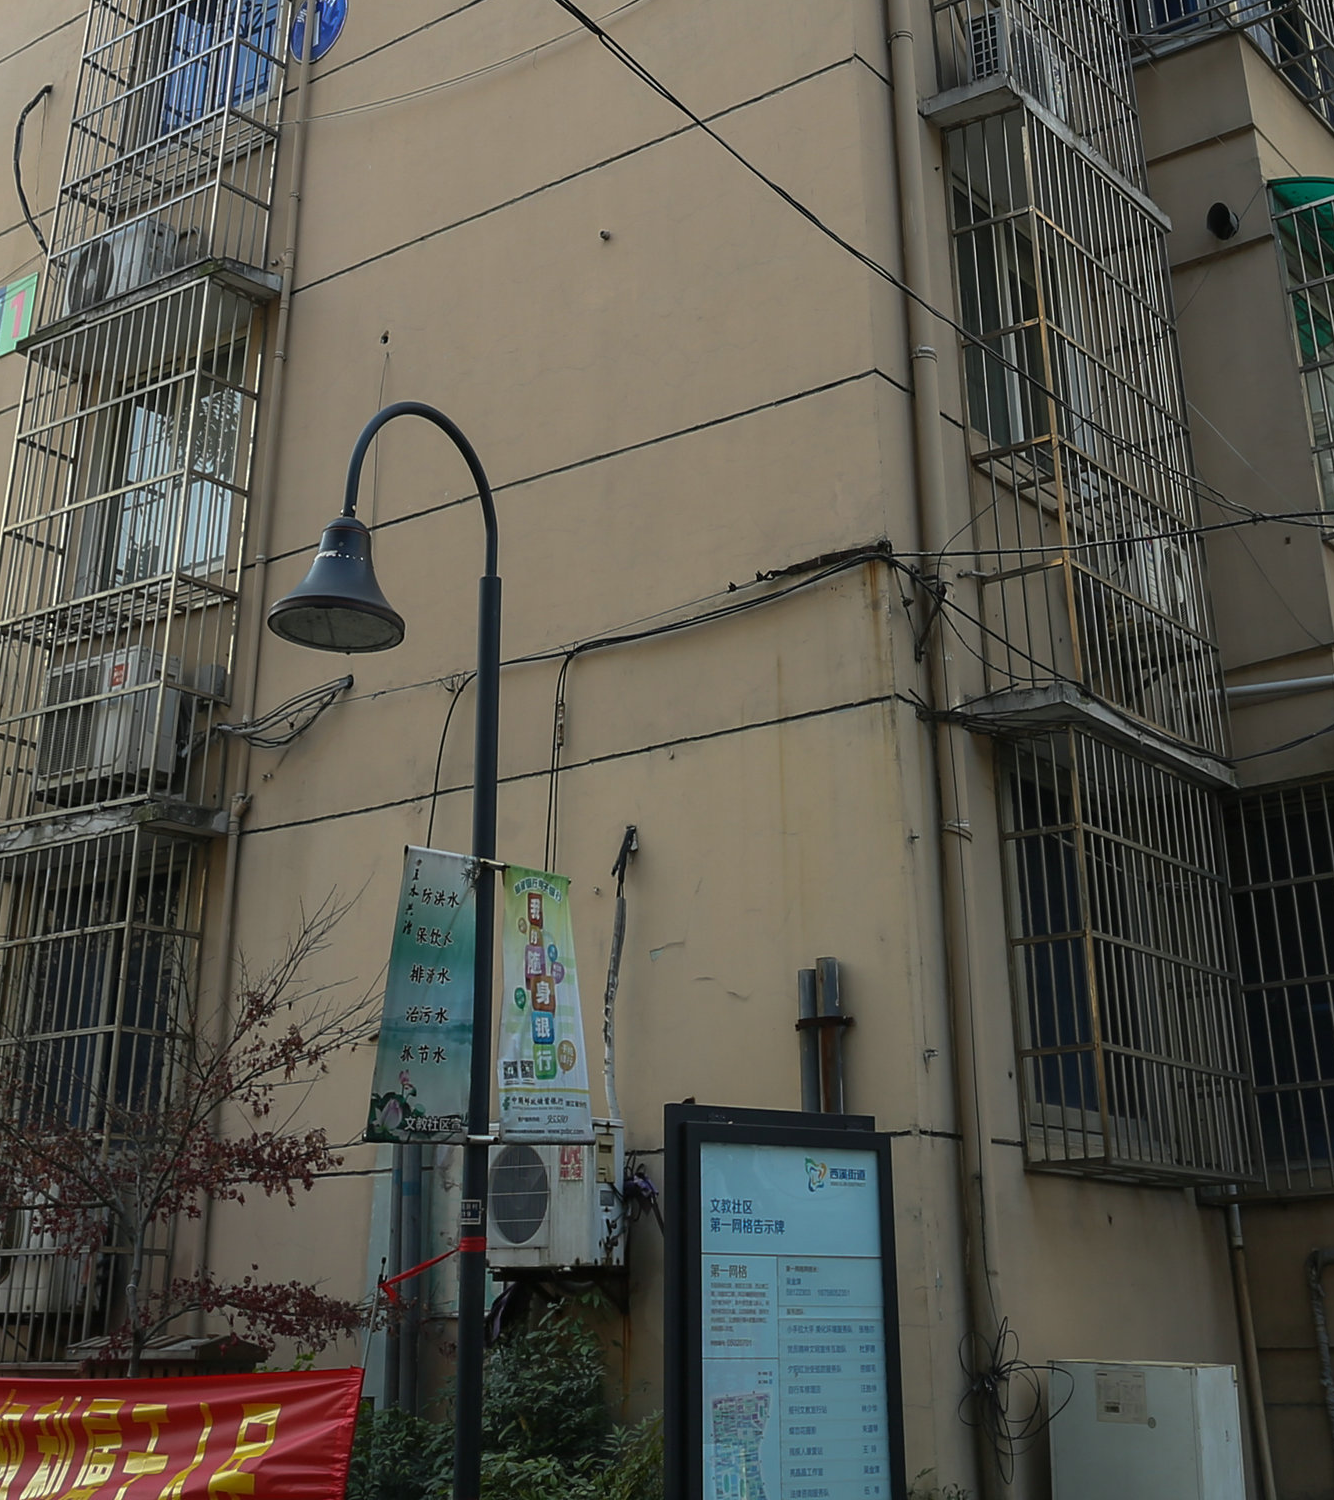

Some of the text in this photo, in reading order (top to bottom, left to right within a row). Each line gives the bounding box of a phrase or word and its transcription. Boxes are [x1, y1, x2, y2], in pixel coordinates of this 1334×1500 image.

[11, 291, 25, 338] 1
[422, 888, 460, 908] 防洪水
[407, 1006, 449, 1024] 治污水
[405, 1116, 462, 1132] 文教社区宣
[829, 1167, 866, 1181] 西溪街道
[710, 1199, 753, 1214] 文教社区
[710, 1218, 785, 1234] 第一网格告示牌
[710, 1264, 747, 1278] 第一网格
